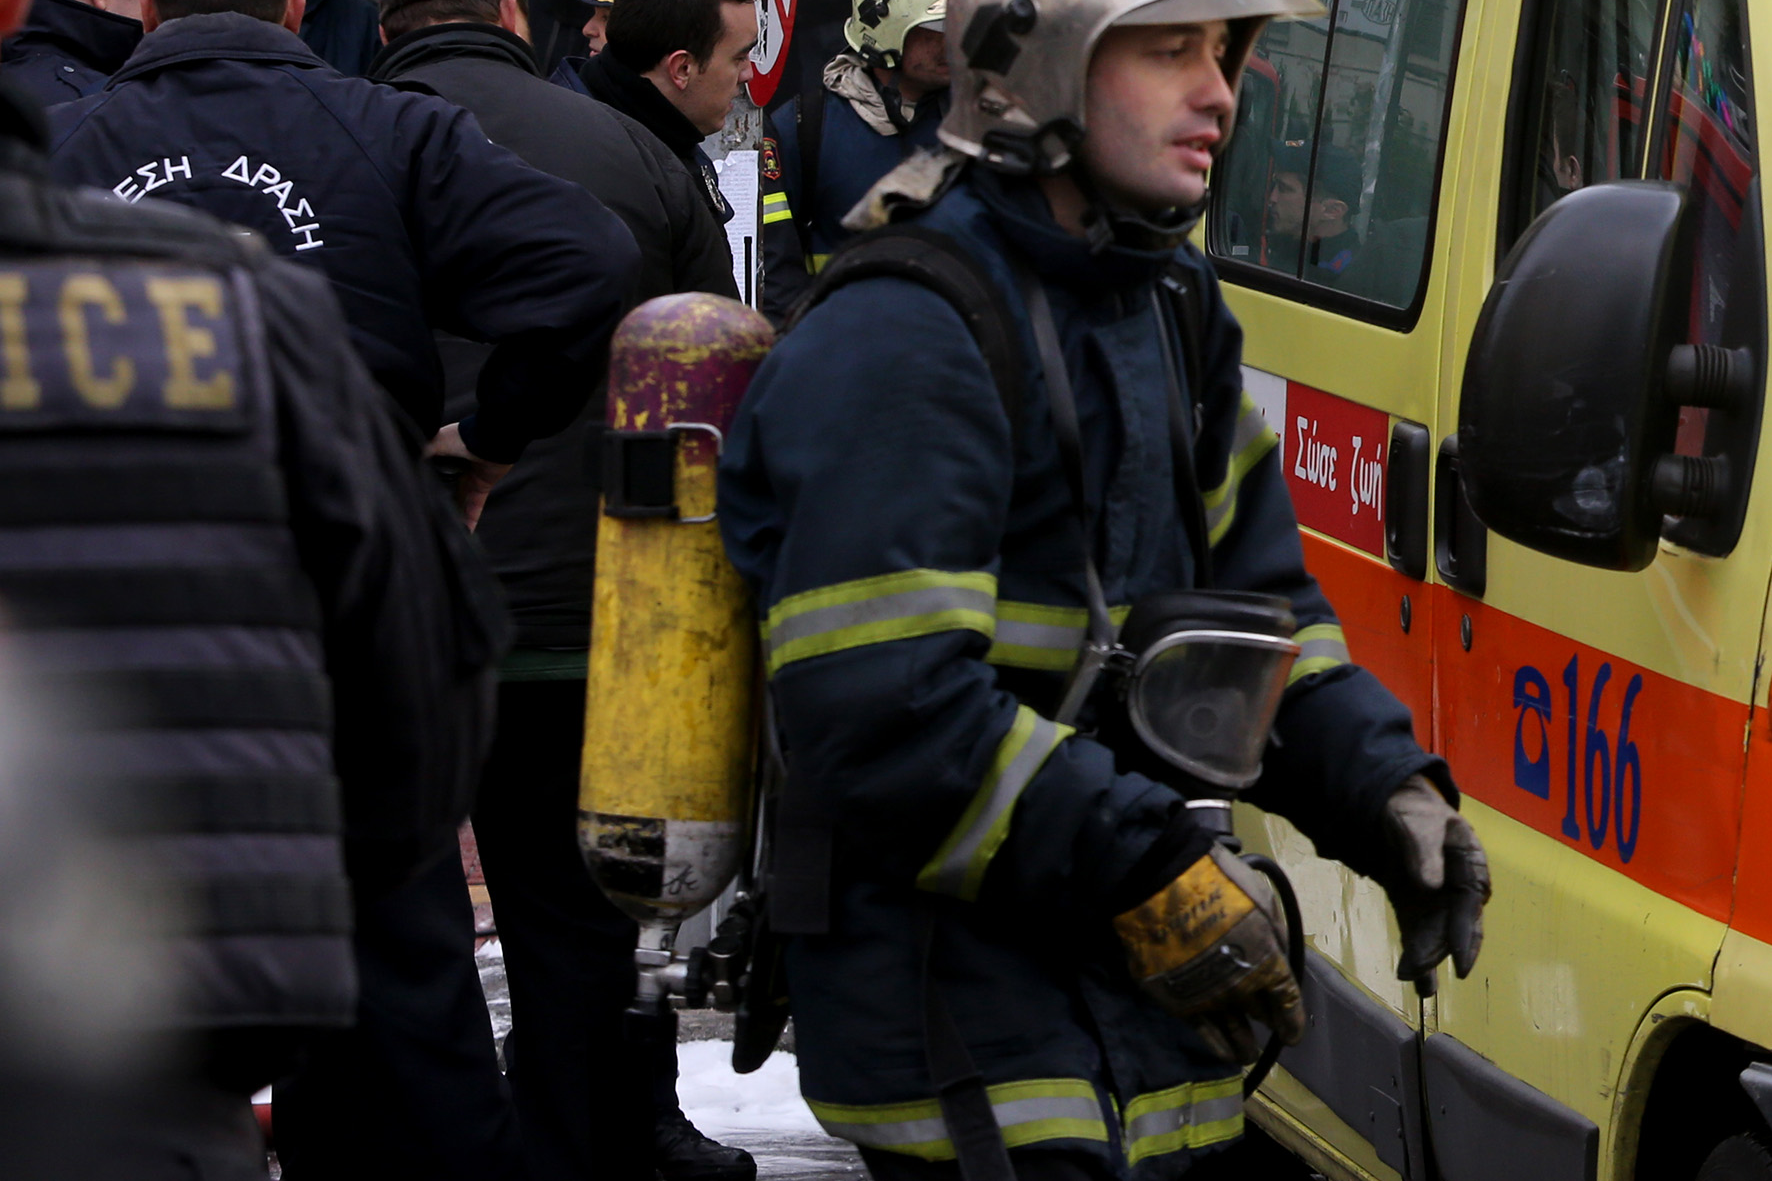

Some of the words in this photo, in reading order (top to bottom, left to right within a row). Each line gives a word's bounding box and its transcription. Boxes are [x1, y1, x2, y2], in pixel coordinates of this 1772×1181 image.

[221, 155, 324, 251] ΔΡΑΣΗ
[0, 272, 238, 411] ICE
[1294, 415, 1338, 492] Σώσε
[1350, 436, 1383, 522] ζωή
[1561, 652, 1643, 864] 166
